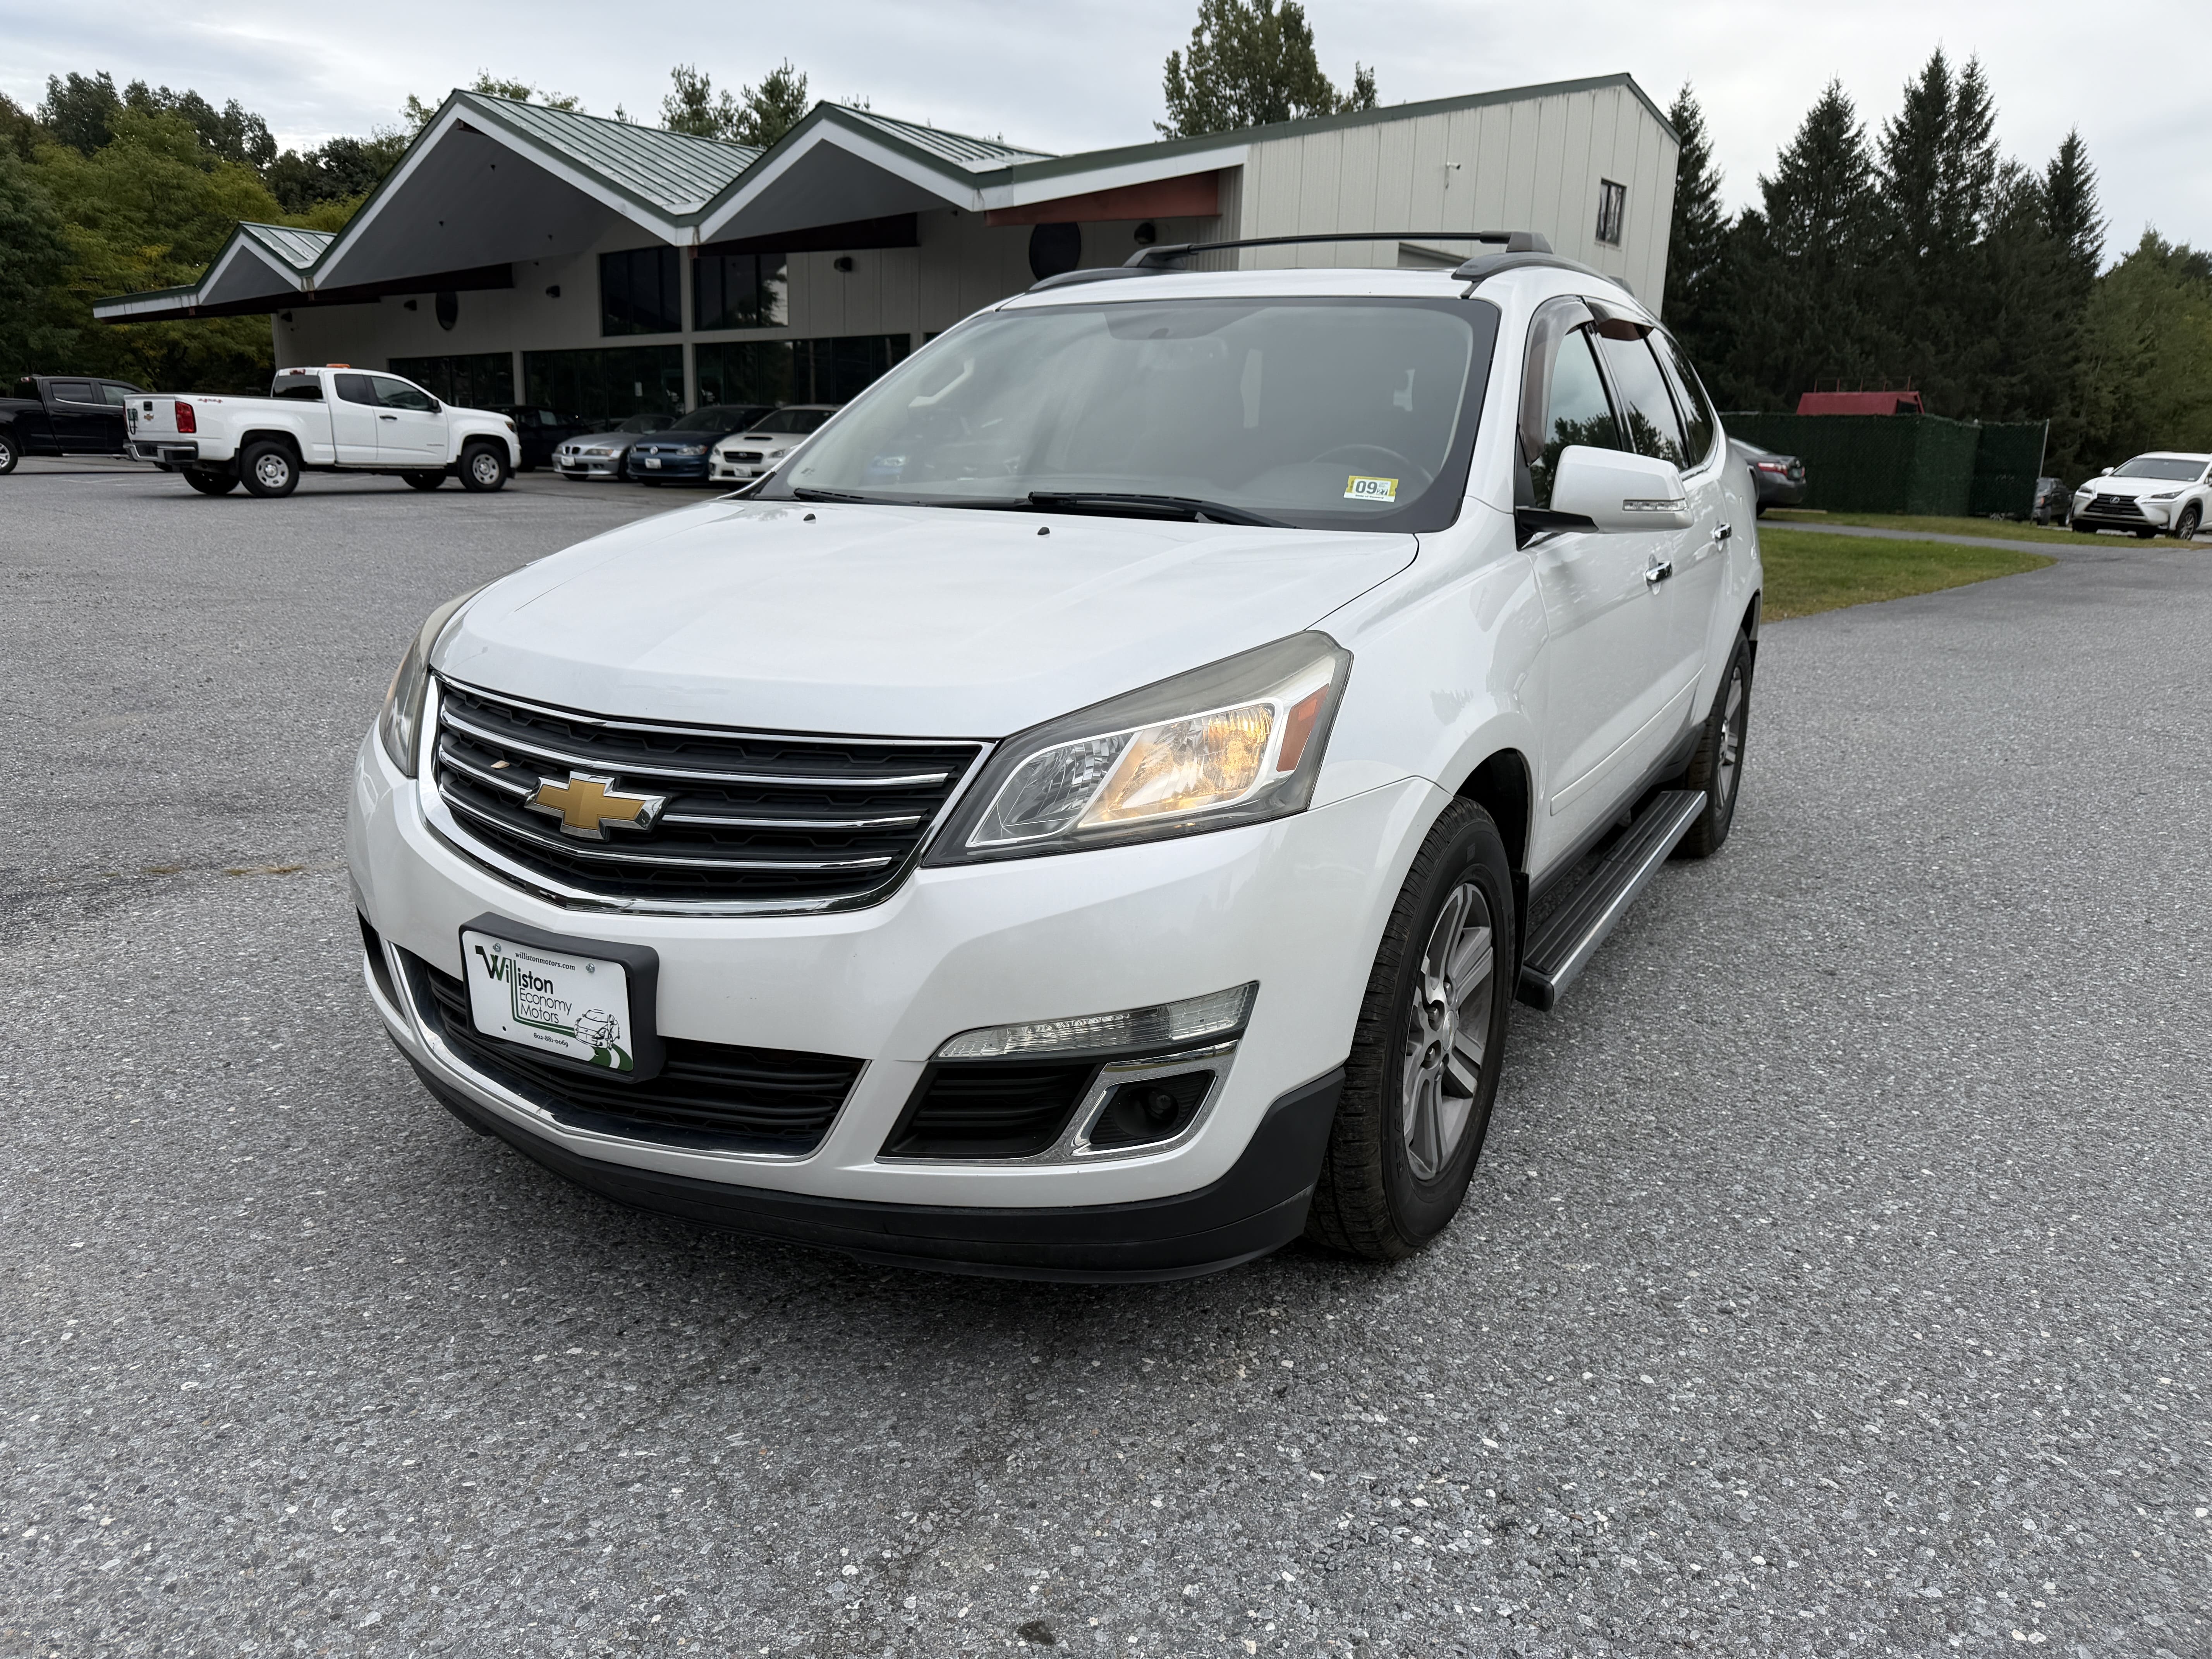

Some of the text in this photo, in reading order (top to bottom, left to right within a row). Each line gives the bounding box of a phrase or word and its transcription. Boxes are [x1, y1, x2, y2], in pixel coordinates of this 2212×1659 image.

[1355, 481, 1377, 494] 09
[475, 945, 553, 994] Williston
[515, 952, 575, 970] willistonmotors.com
[520, 988, 572, 1015] Economy
[521, 1002, 559, 1024] Motors
[534, 1032, 568, 1048] 802-881-0069
